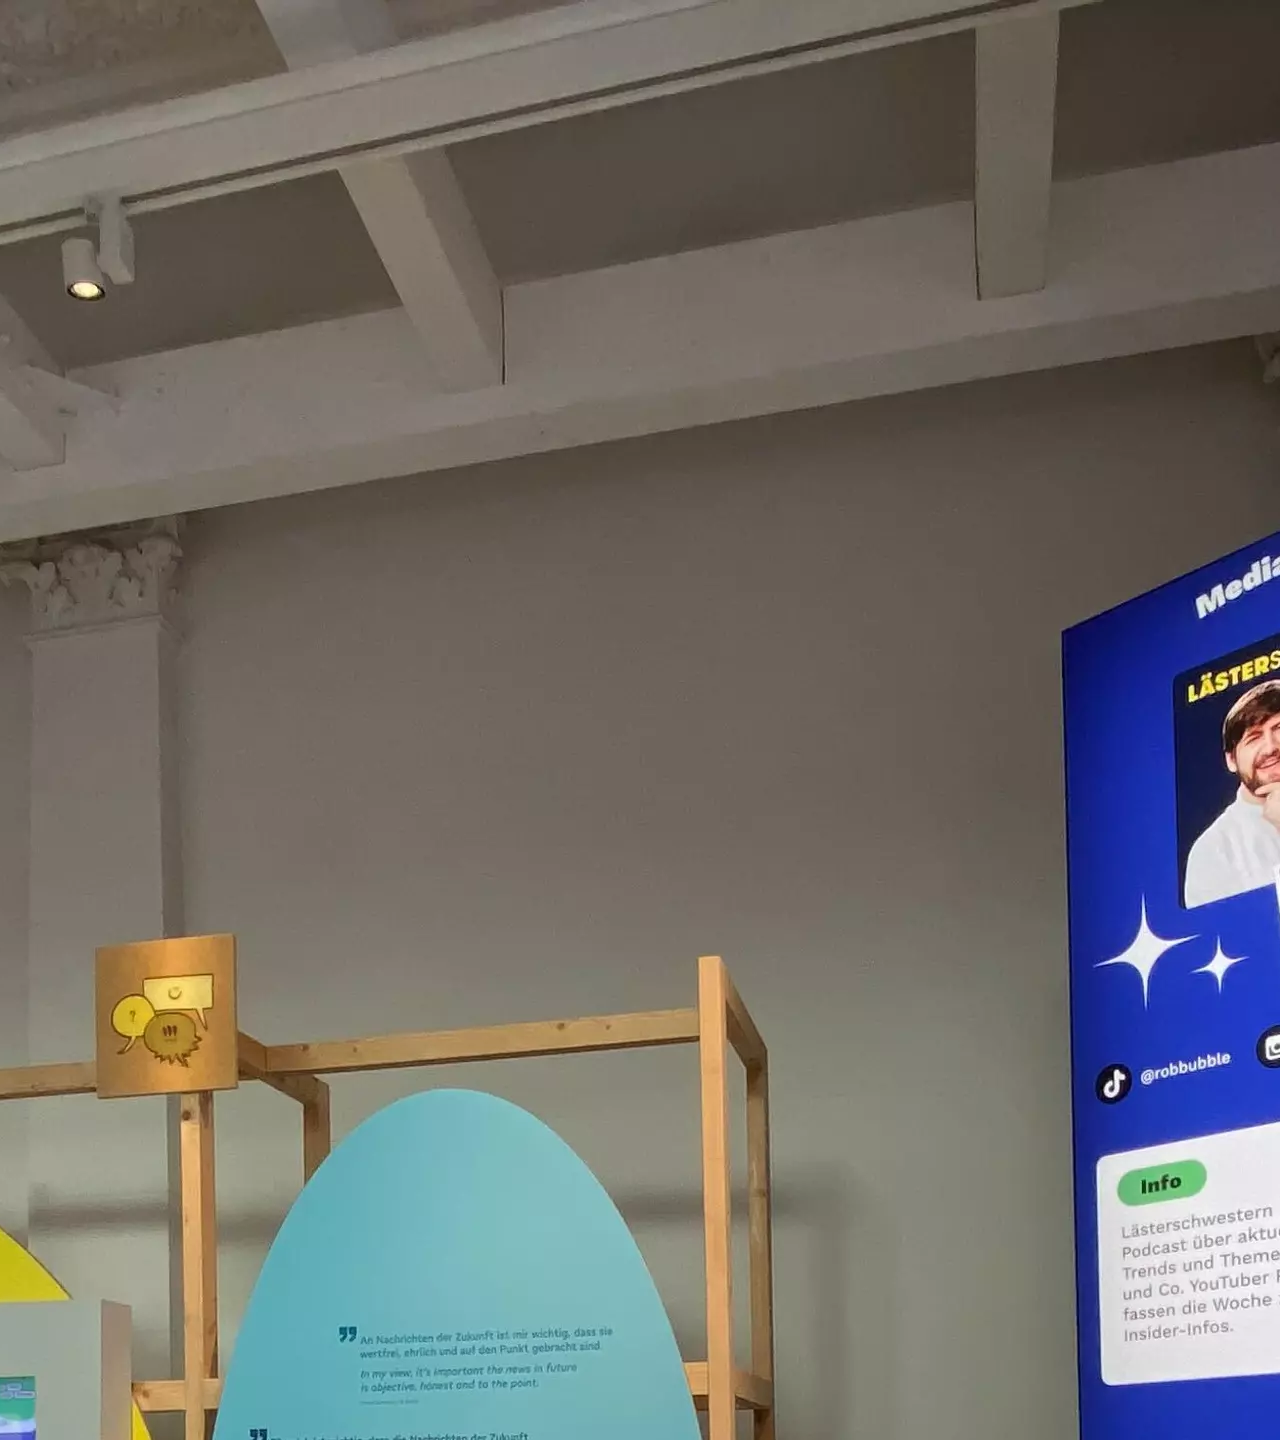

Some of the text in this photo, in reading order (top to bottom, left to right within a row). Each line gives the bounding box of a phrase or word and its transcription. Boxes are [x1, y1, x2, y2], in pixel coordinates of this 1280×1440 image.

[1140, 1050, 1232, 1085] @robbubble
[1140, 1174, 1182, 1195] Info
[1120, 1206, 1273, 1241] Lästerschwestern
[1122, 1238, 1188, 1262] Podcast
[1192, 1233, 1233, 1251] über
[1121, 1259, 1177, 1282] Trends
[1182, 1253, 1214, 1274] und
[1122, 1282, 1153, 1302] und
[1158, 1282, 1185, 1298] Co.
[1189, 1271, 1270, 1293] YouTuber
[1121, 1305, 1176, 1323] fassen
[1181, 1298, 1207, 1316] die
[1212, 1292, 1273, 1313] Woche
[1123, 1318, 1234, 1343] Insider-Infos.
